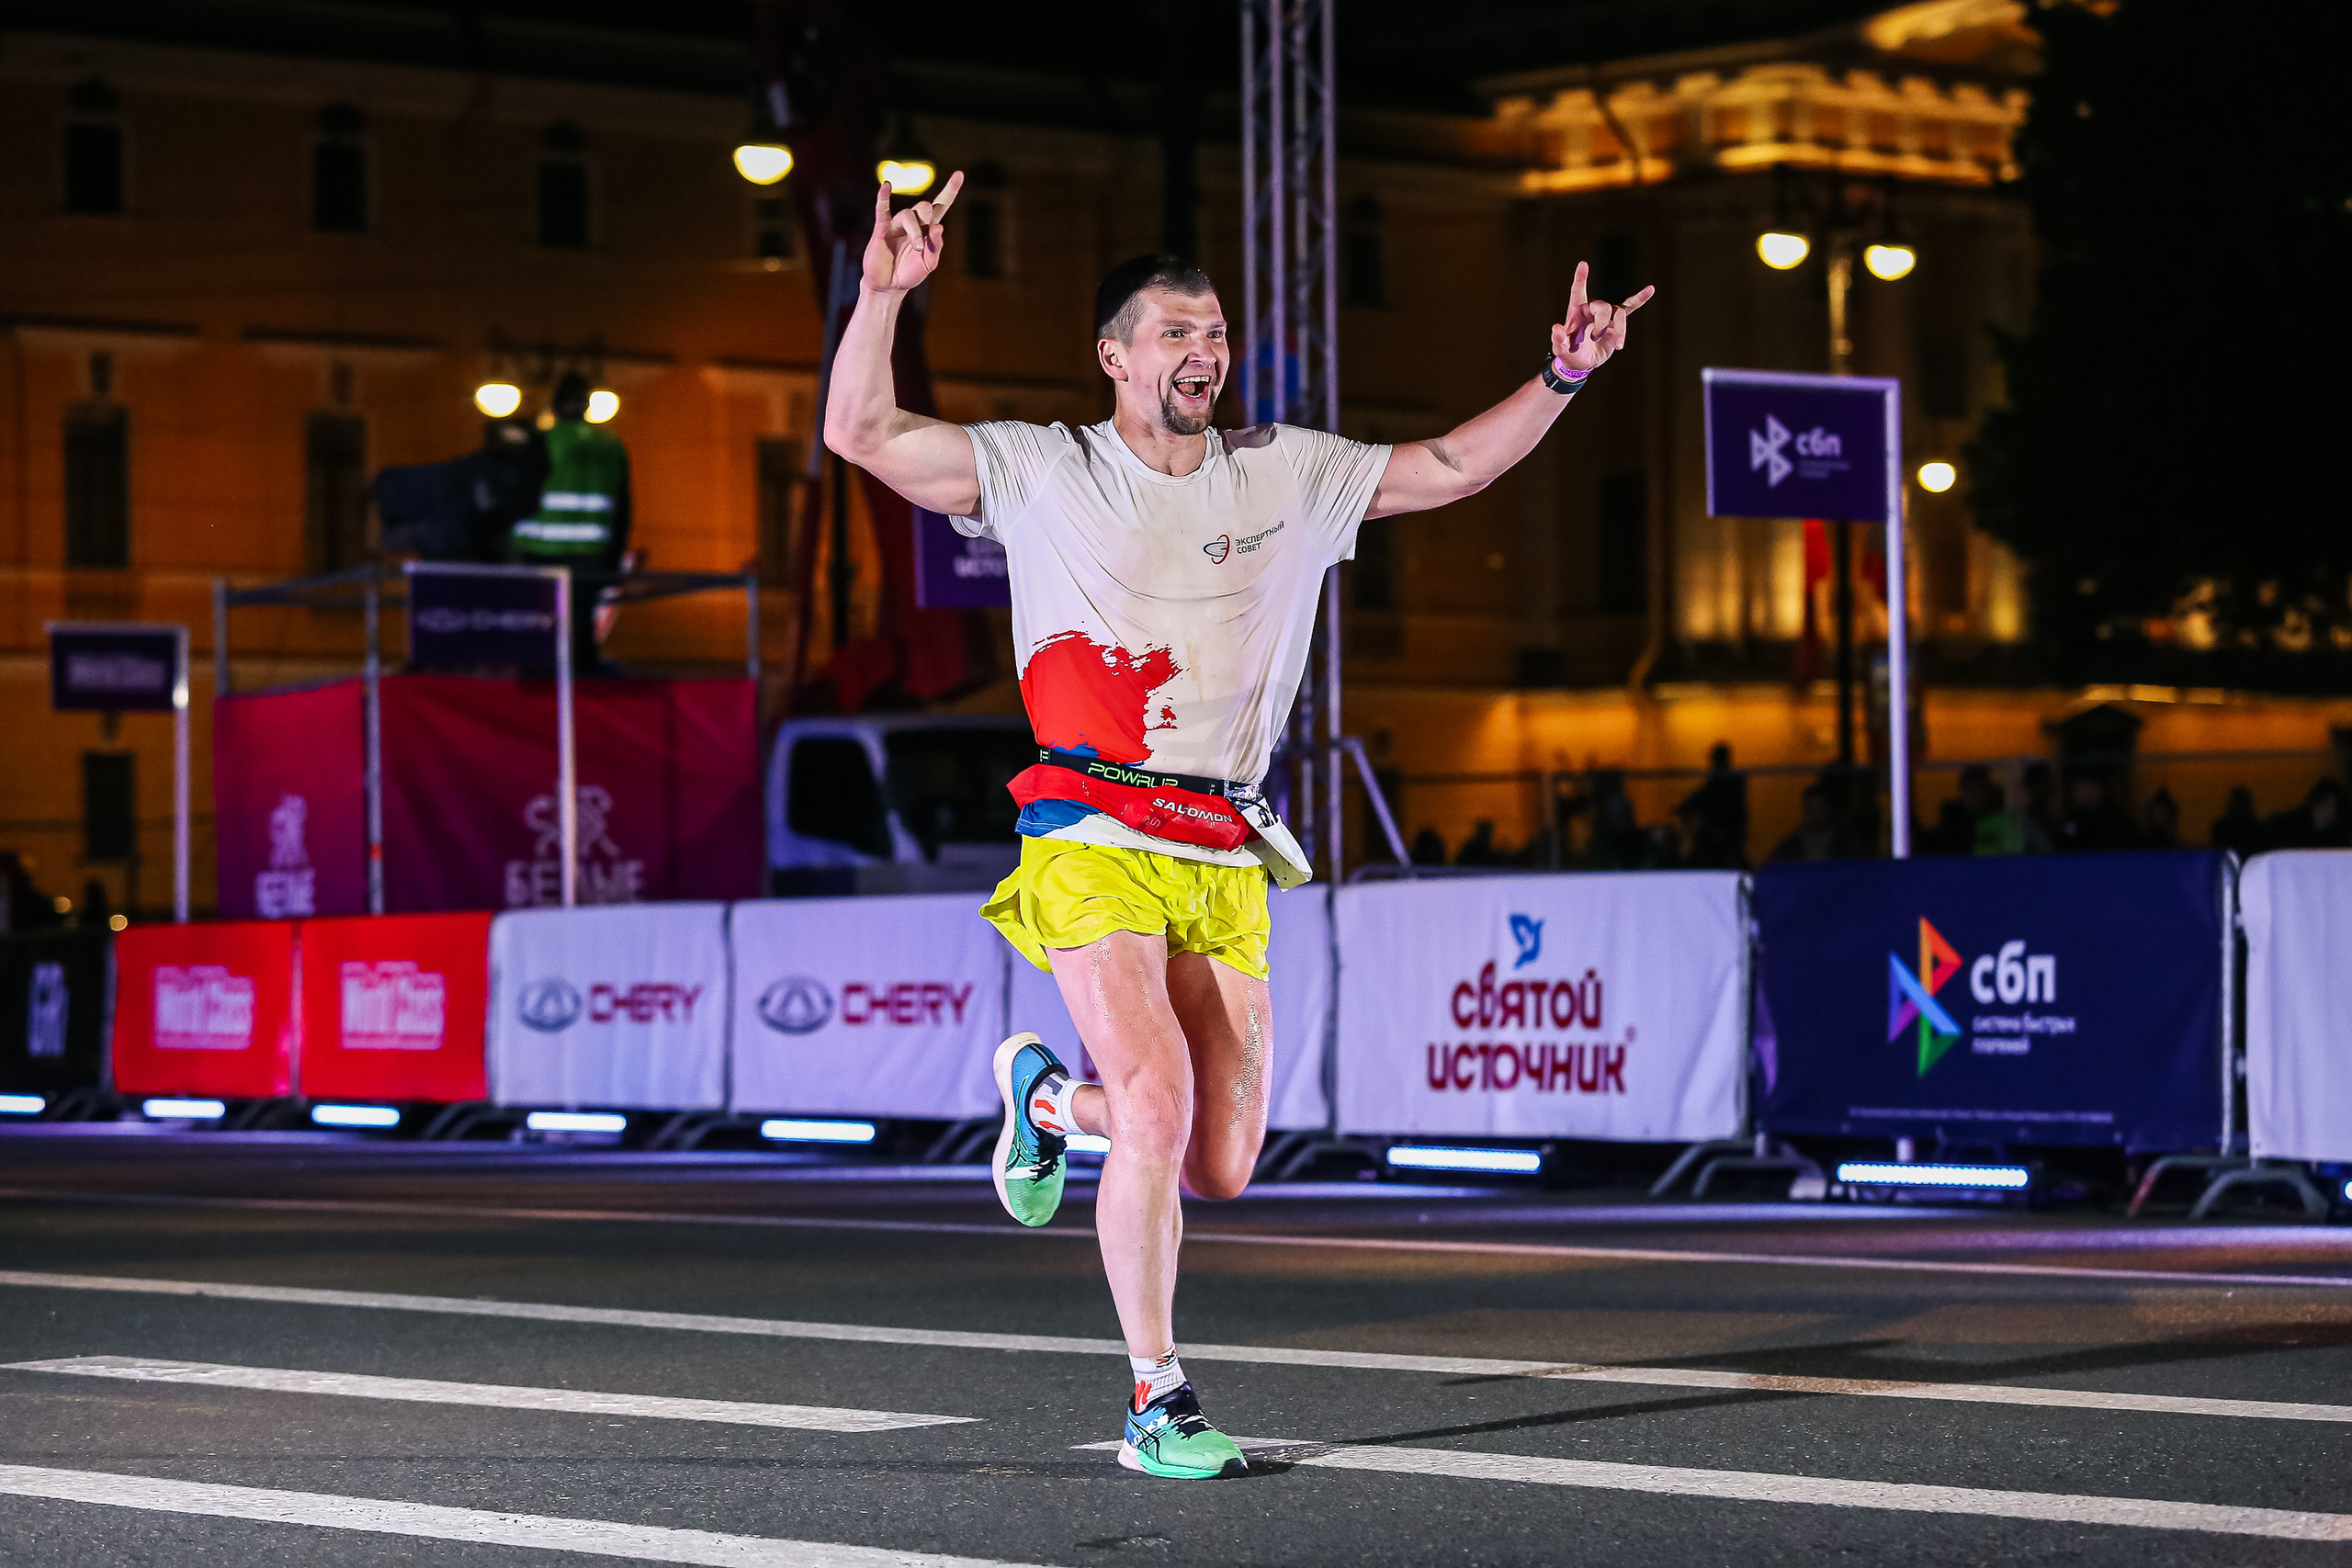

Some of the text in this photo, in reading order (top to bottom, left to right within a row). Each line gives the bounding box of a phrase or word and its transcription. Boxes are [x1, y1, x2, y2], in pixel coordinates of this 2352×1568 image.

[1235, 520, 1284, 547] ЭКСПЕРТНЫЙ
[1237, 542, 1261, 554] СОВЕТ
[1152, 797, 1233, 823] SALOMON
[1970, 939, 2056, 1004] сбп
[589, 982, 703, 1024] CHERY
[841, 981, 974, 1026] CHERY
